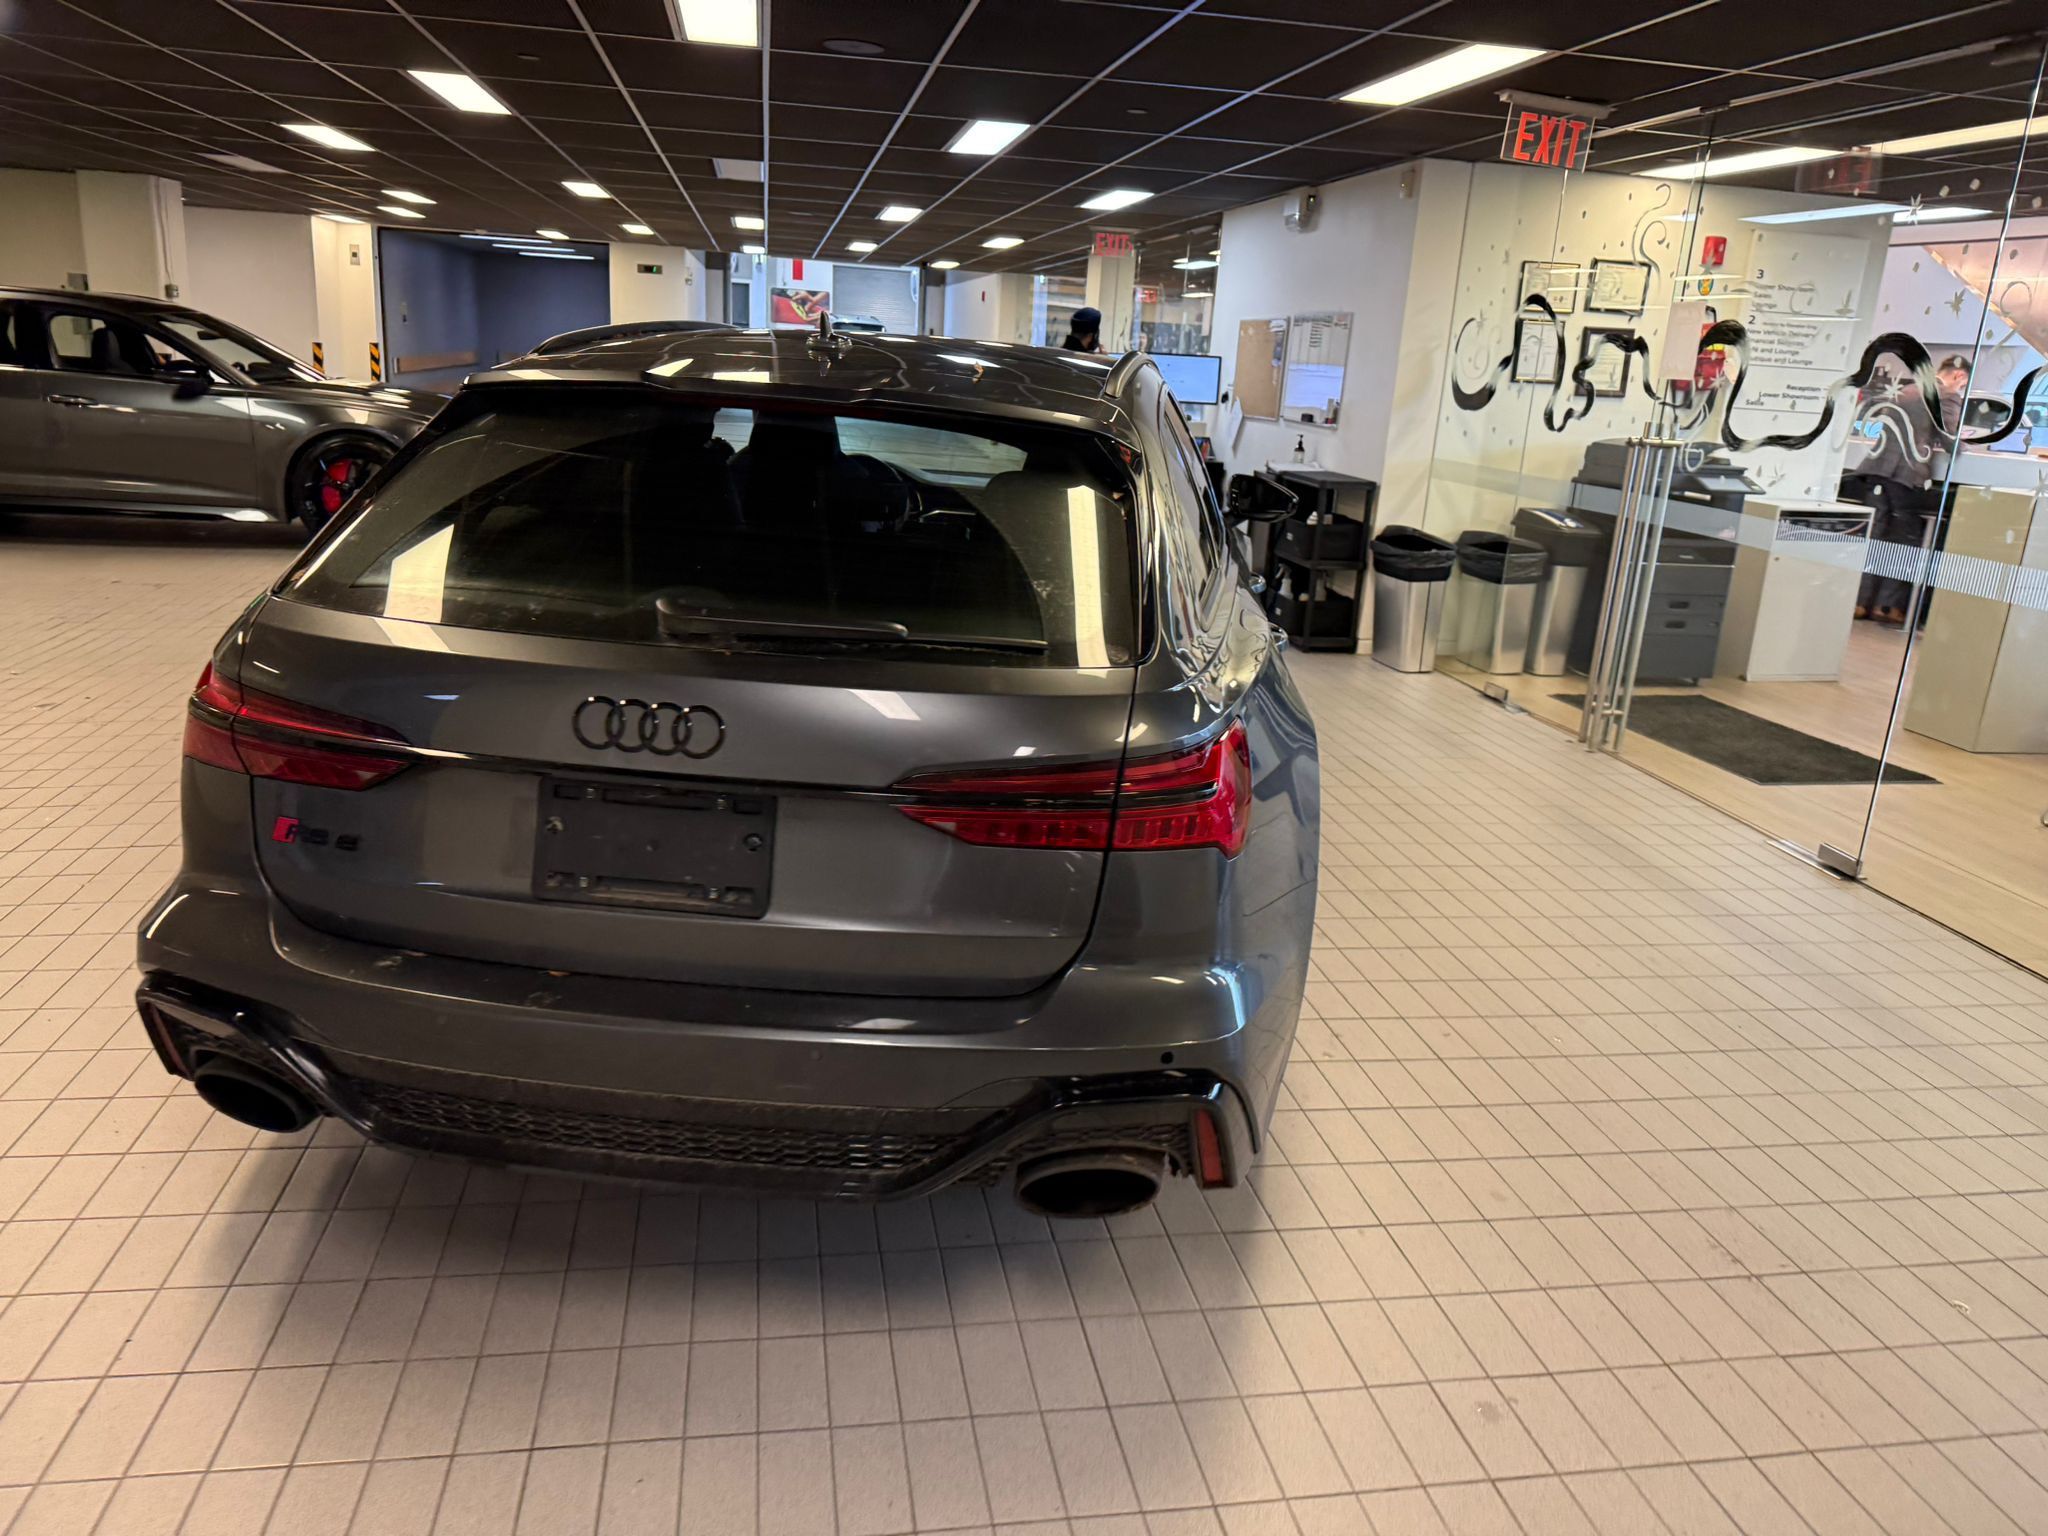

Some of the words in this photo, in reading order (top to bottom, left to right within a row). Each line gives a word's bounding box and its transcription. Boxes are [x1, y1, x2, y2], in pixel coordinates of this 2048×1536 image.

[1513, 112, 1586, 169] EXIT
[1095, 232, 1131, 257] EXIT
[1756, 269, 1764, 279] 3
[1748, 315, 1756, 325] 2
[1774, 348, 1799, 357] Lounge
[1786, 384, 1821, 392] Reception
[1782, 392, 1819, 400] Showroom
